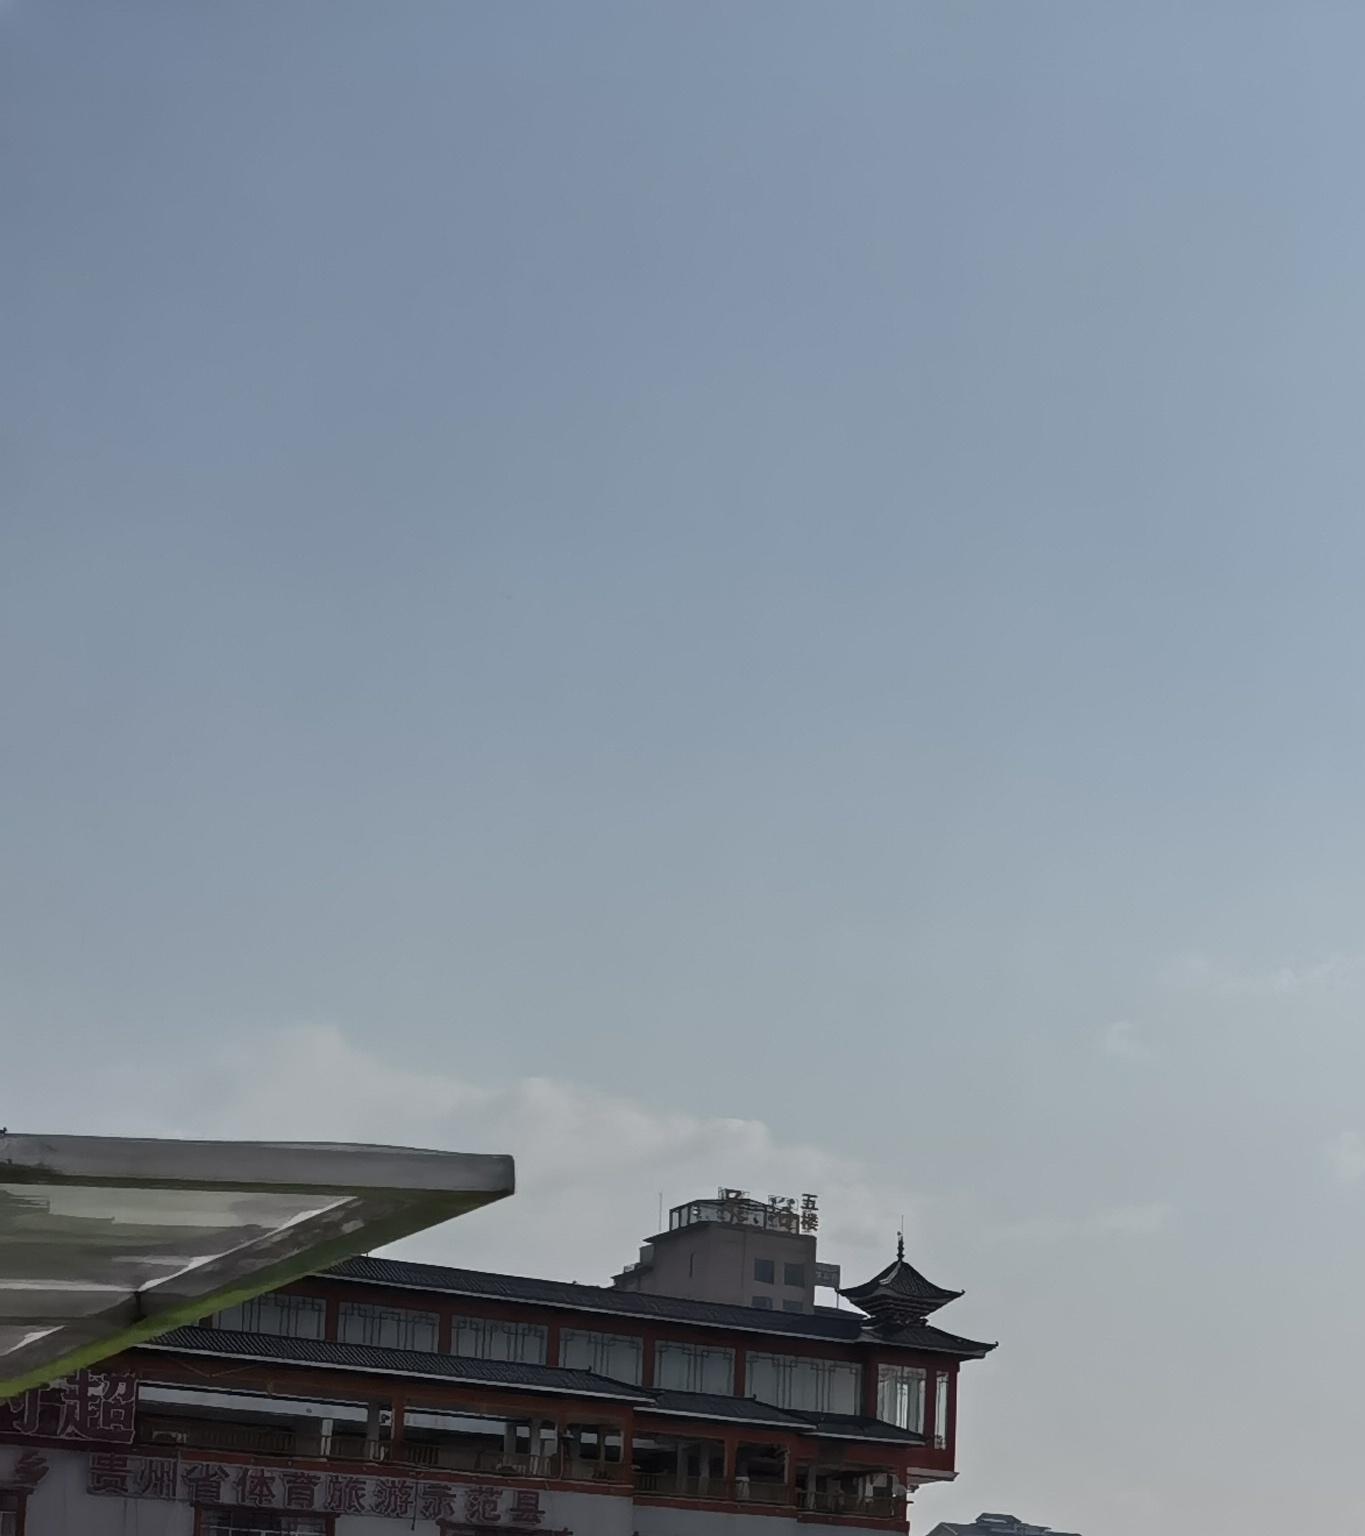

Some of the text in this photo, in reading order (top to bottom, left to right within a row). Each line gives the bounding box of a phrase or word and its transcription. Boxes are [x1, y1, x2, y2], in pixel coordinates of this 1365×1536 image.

[87, 1453, 546, 1525] 贵州省体育旅游示范县
